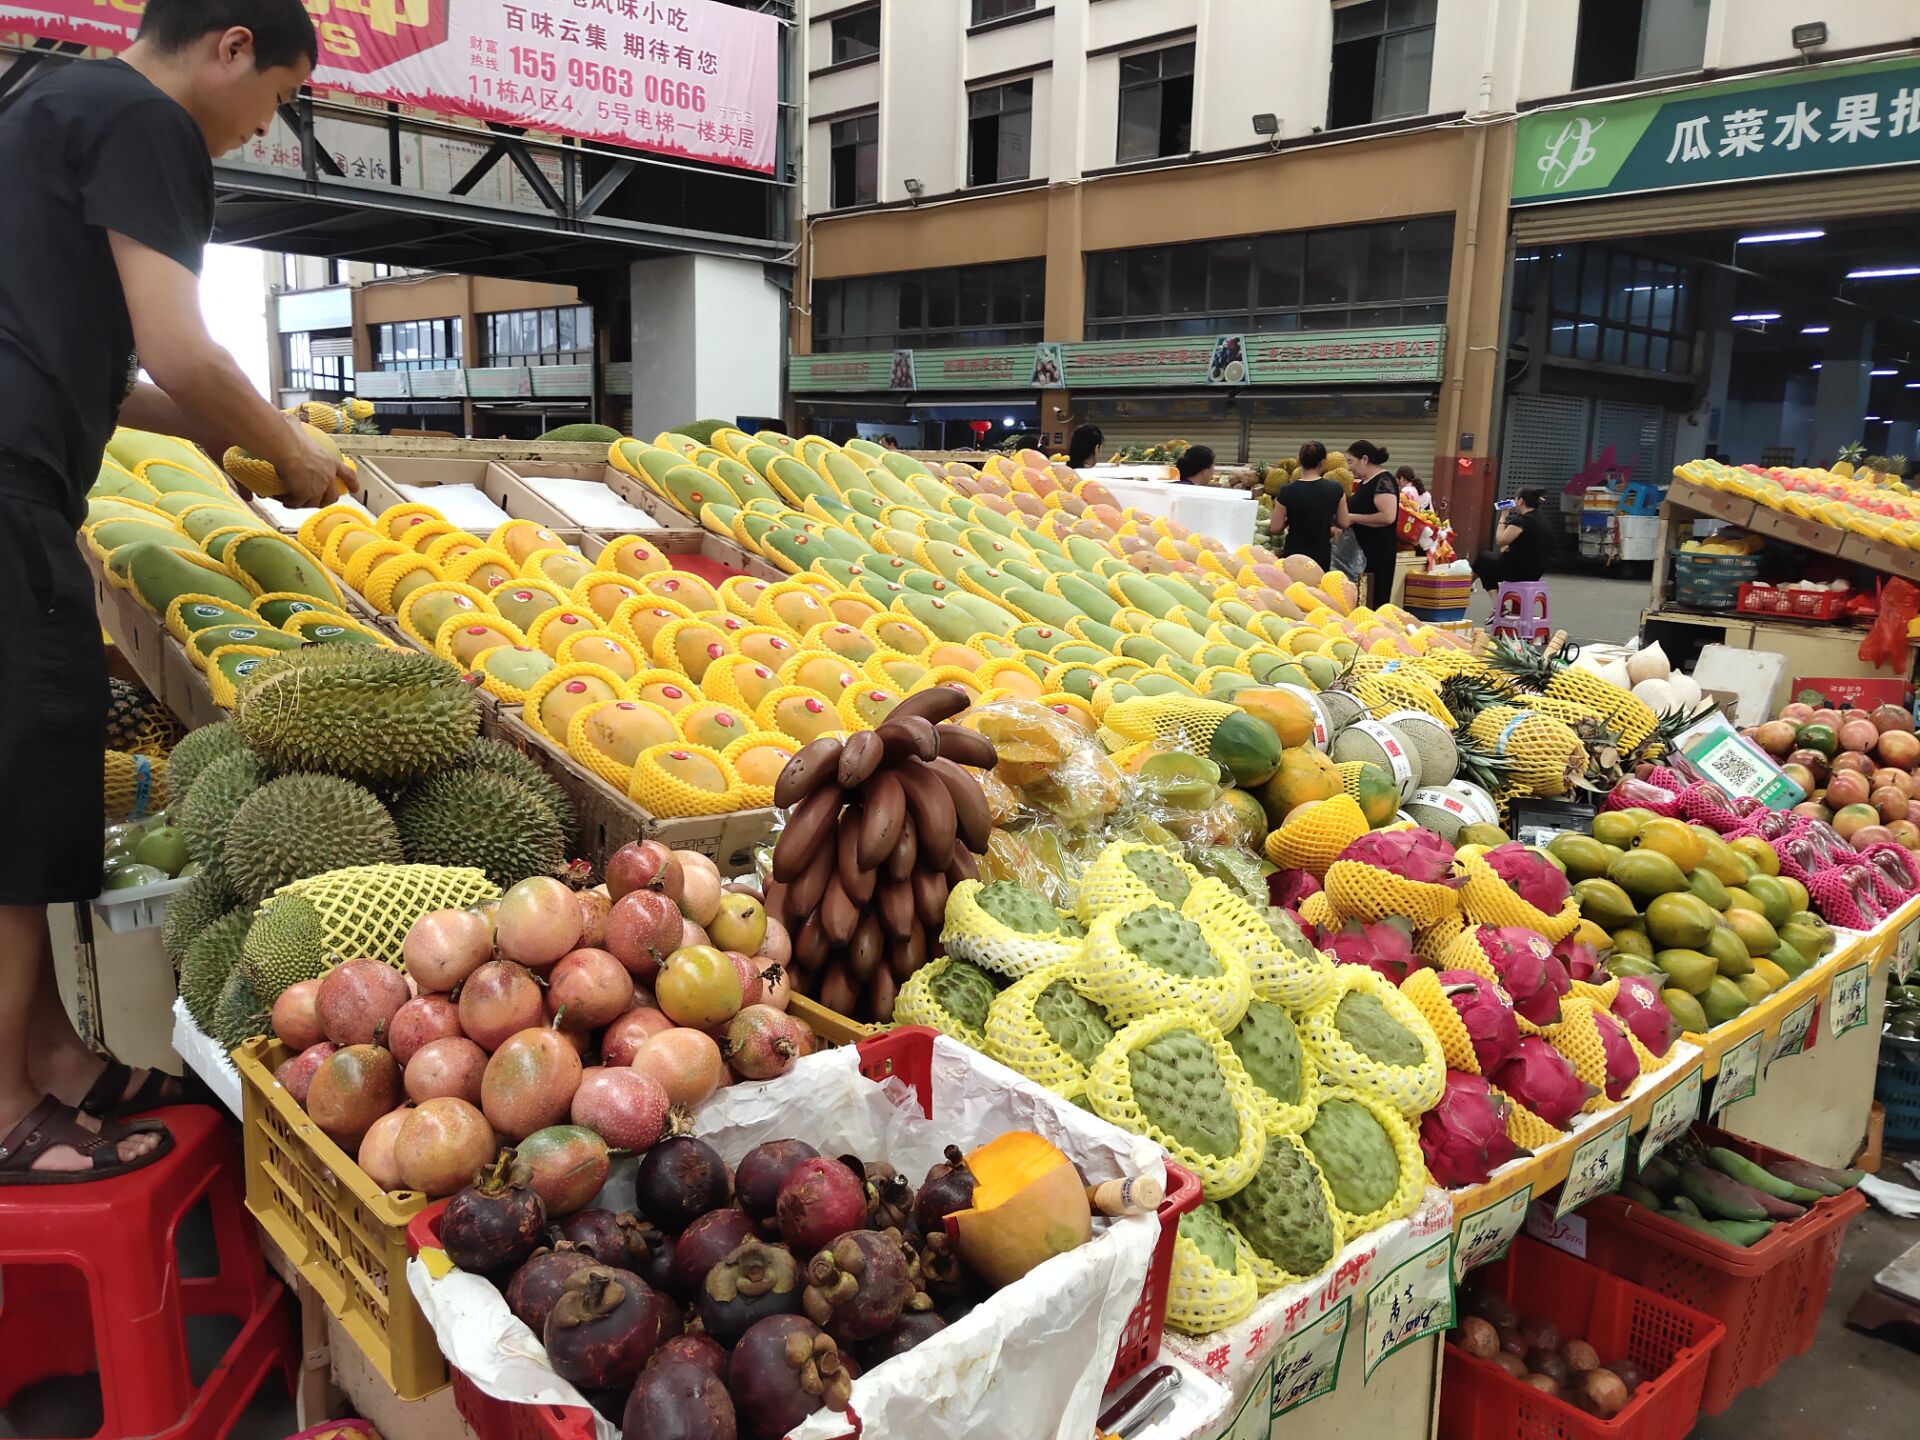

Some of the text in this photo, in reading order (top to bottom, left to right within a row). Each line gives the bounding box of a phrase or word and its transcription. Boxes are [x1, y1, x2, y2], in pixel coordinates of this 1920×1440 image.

[469, 36, 499, 54] 财富
[503, 4, 719, 75] 百味云集 期待有您
[469, 53, 500, 71] 热线
[508, 46, 707, 113] 155 9563 0666
